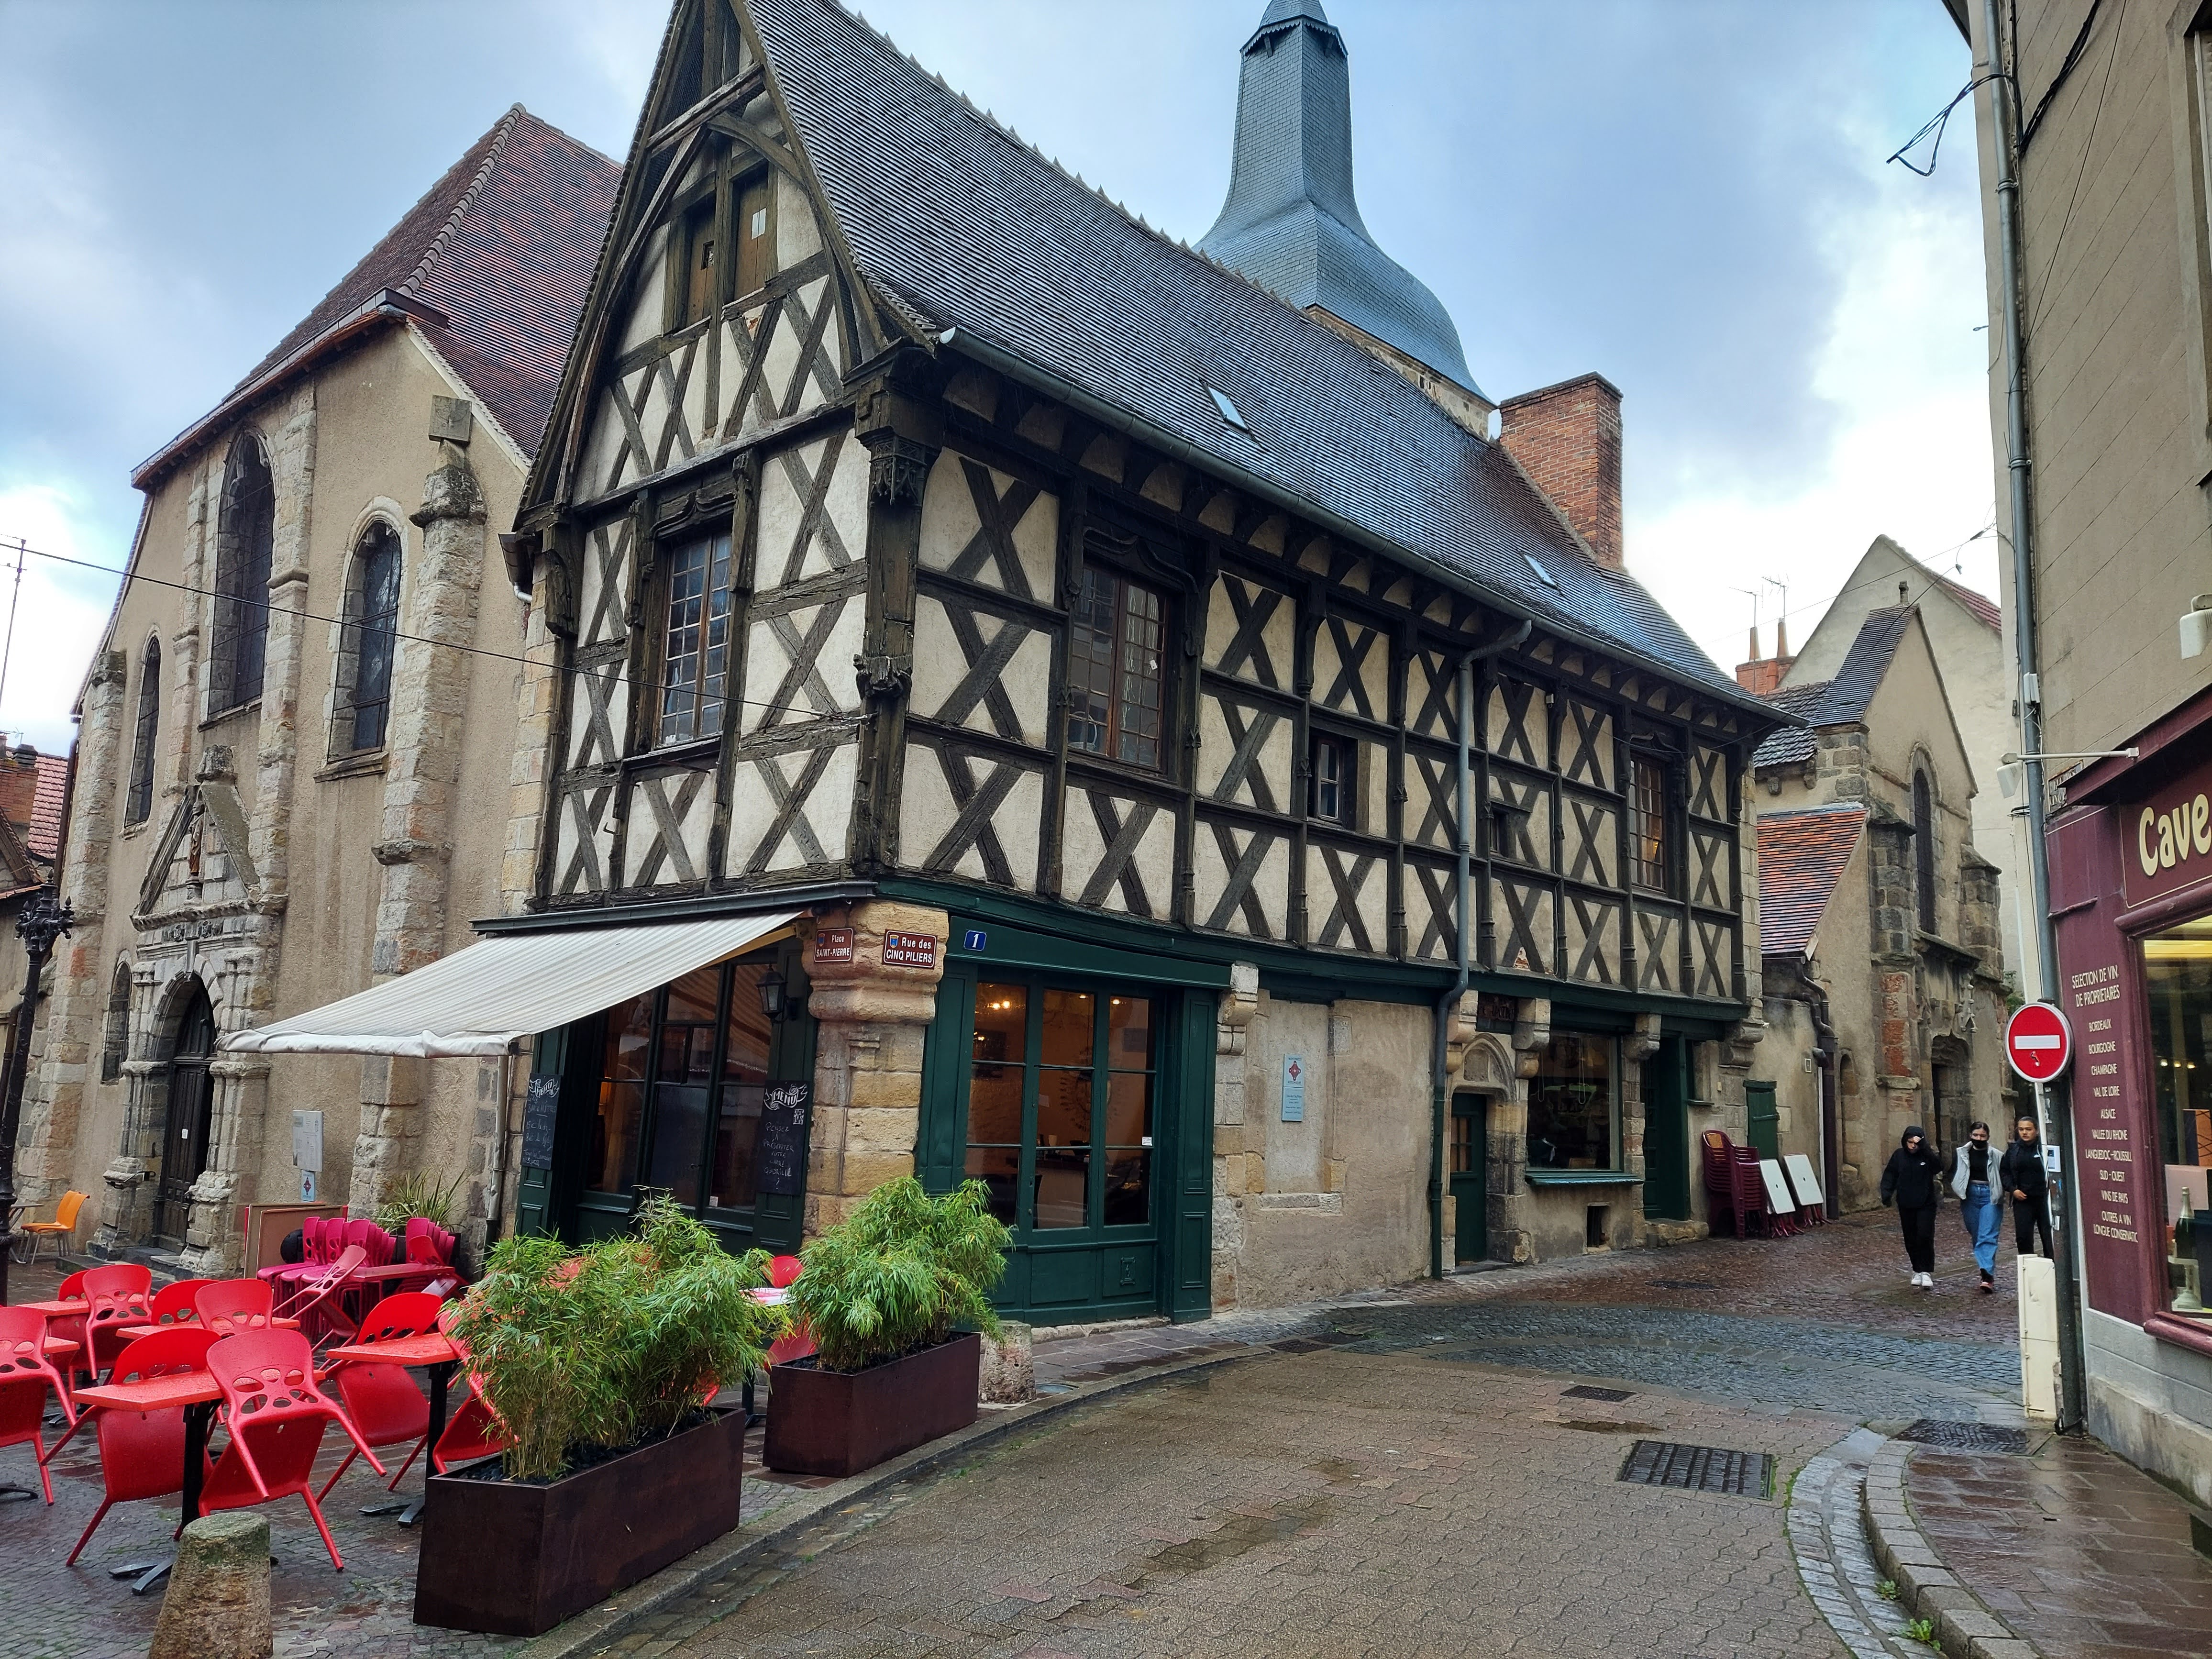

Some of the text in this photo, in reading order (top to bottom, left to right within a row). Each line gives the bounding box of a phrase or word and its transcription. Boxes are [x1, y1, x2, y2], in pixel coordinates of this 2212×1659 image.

[2139, 794, 2212, 876] Cave
[831, 934, 845, 943] Place
[901, 937, 932, 950] Rue des
[972, 933, 979, 948] 1
[816, 947, 850, 958] SAINT-PIERRE
[886, 950, 933, 963] CINQ PILIERS
[2072, 970, 2099, 989] SELECTION
[2099, 967, 2107, 983] DE
[2076, 984, 2120, 1007] DE PROPRIETAIRES
[2089, 1018, 2112, 1032] BORDEAUX
[2089, 1041, 2116, 1054] BOURGOGNE
[2091, 1063, 2118, 1075] CHAMPAGNE
[536, 1082, 553, 1096] MENU
[2093, 1085, 2120, 1097] VAL DE LOIRE
[773, 1090, 797, 1106] MENU
[2101, 1108, 2116, 1119] ALSACE
[2105, 1129, 2112, 1139] DU
[2101, 1190, 2112, 1201] VINS
[2112, 1191, 2118, 1202] DE
[2119, 1214, 2123, 1224] A
